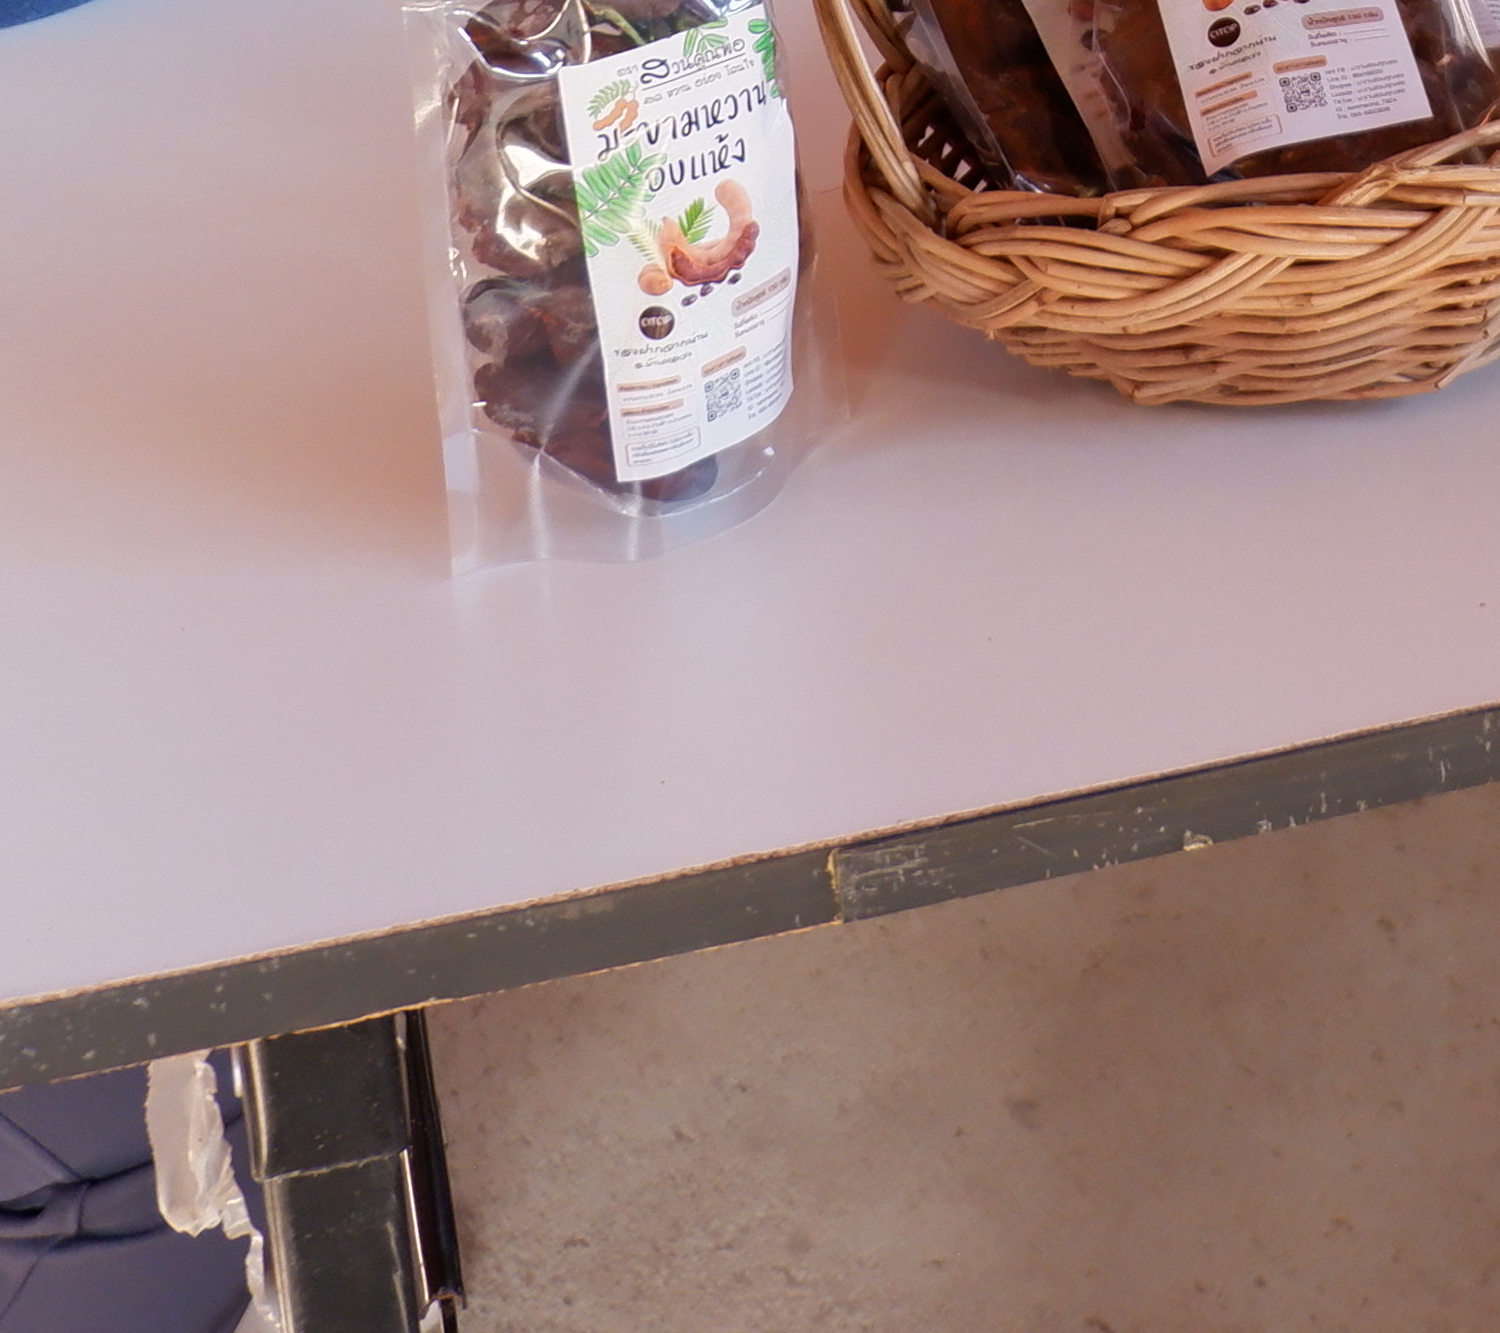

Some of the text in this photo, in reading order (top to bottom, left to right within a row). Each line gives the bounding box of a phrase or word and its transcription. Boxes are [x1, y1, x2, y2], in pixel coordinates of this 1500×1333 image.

[1209, 23, 1238, 39] OTOP
[597, 81, 767, 162] มะขามหวาน
[645, 133, 746, 192] อบแห้ง
[640, 314, 673, 327] OTOP
